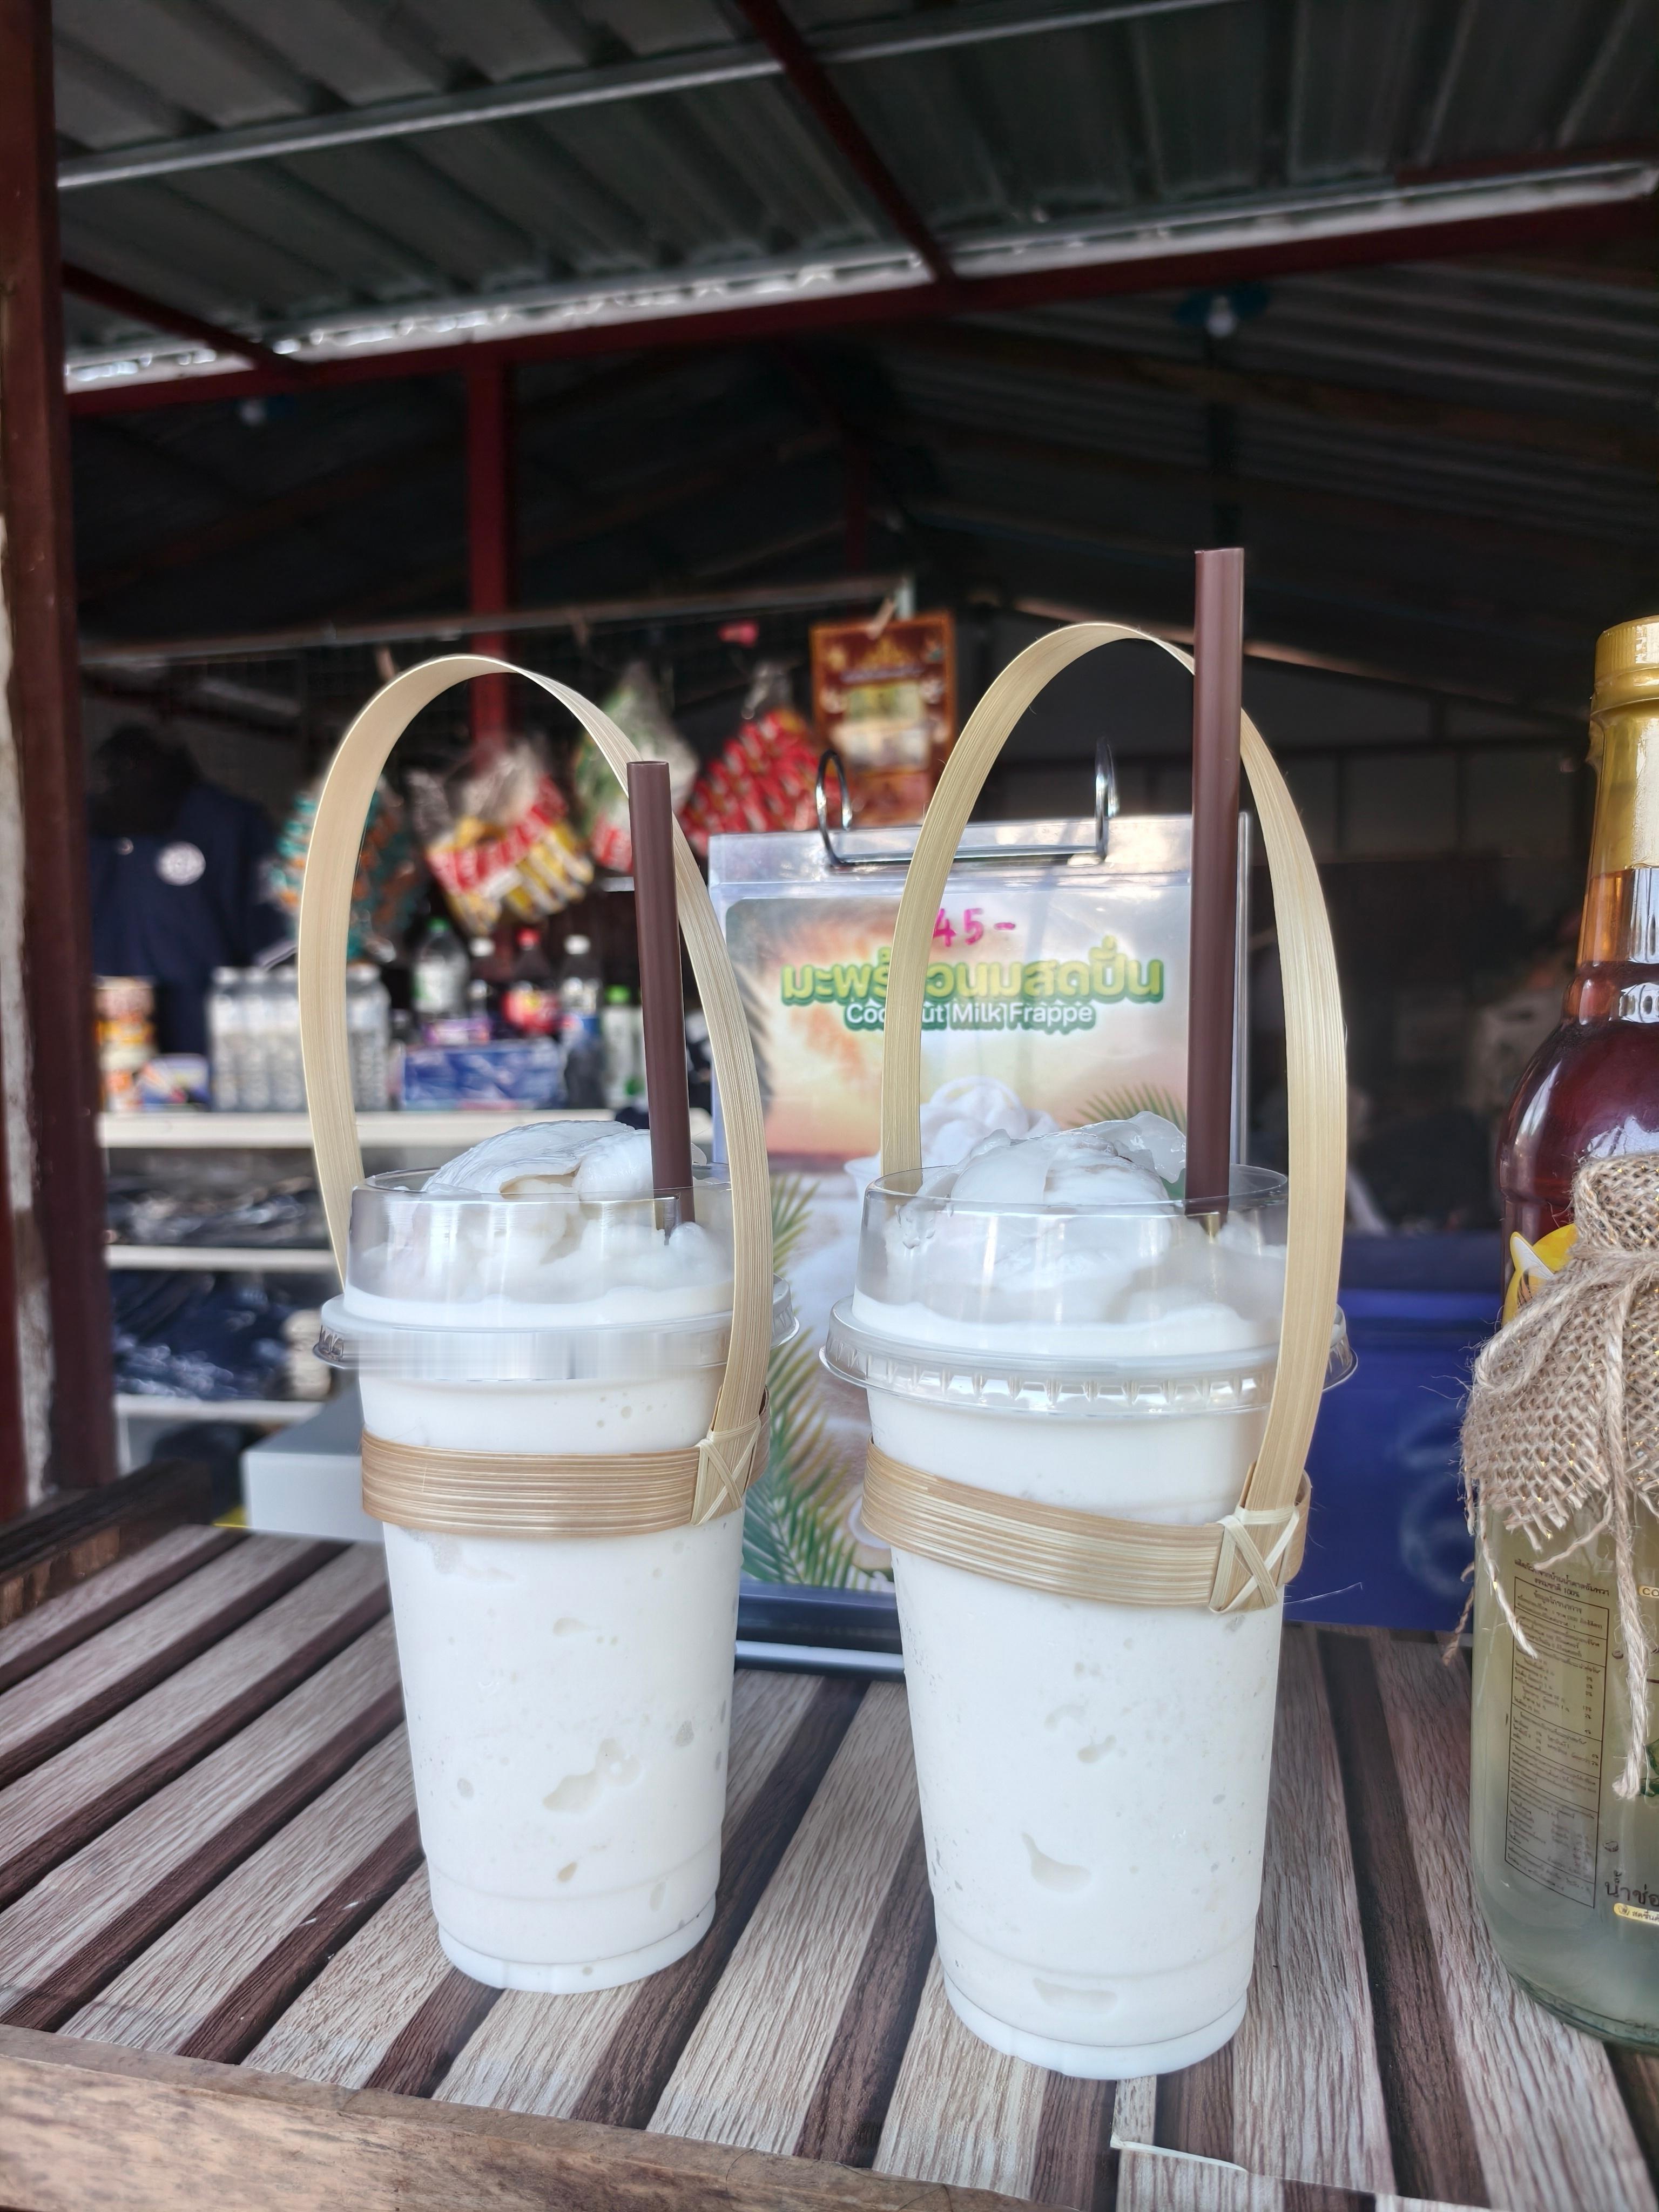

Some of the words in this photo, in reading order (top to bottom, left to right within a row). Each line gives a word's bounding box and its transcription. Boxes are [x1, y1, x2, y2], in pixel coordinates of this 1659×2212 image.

[781, 935, 1162, 1000] มะพร้วนมสดปั่น
[847, 1003, 944, 1023] Cout
[953, 1002, 1001, 1023] Milk
[1009, 1002, 1092, 1027] Frappe
